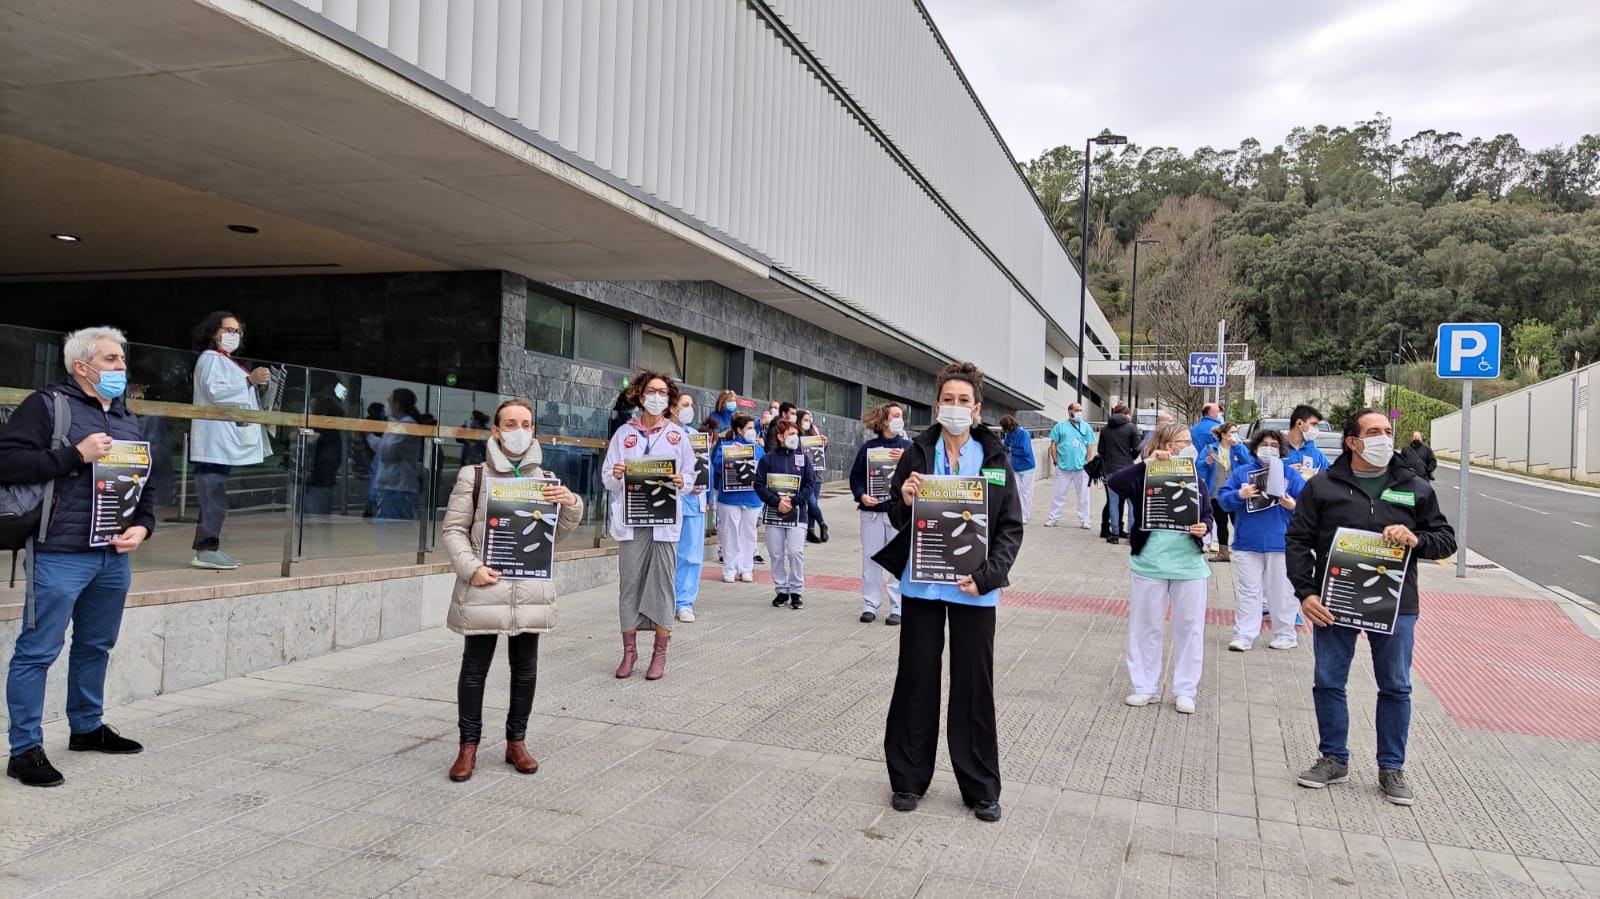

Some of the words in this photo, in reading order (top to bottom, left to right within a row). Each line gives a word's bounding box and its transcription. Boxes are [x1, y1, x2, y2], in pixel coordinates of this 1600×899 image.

[1450, 330, 1487, 371] P
[930, 489, 941, 497] NO
[943, 490, 972, 498] QUIERE
[1348, 542, 1360, 550] NO
[1362, 545, 1391, 555] QUIERE
